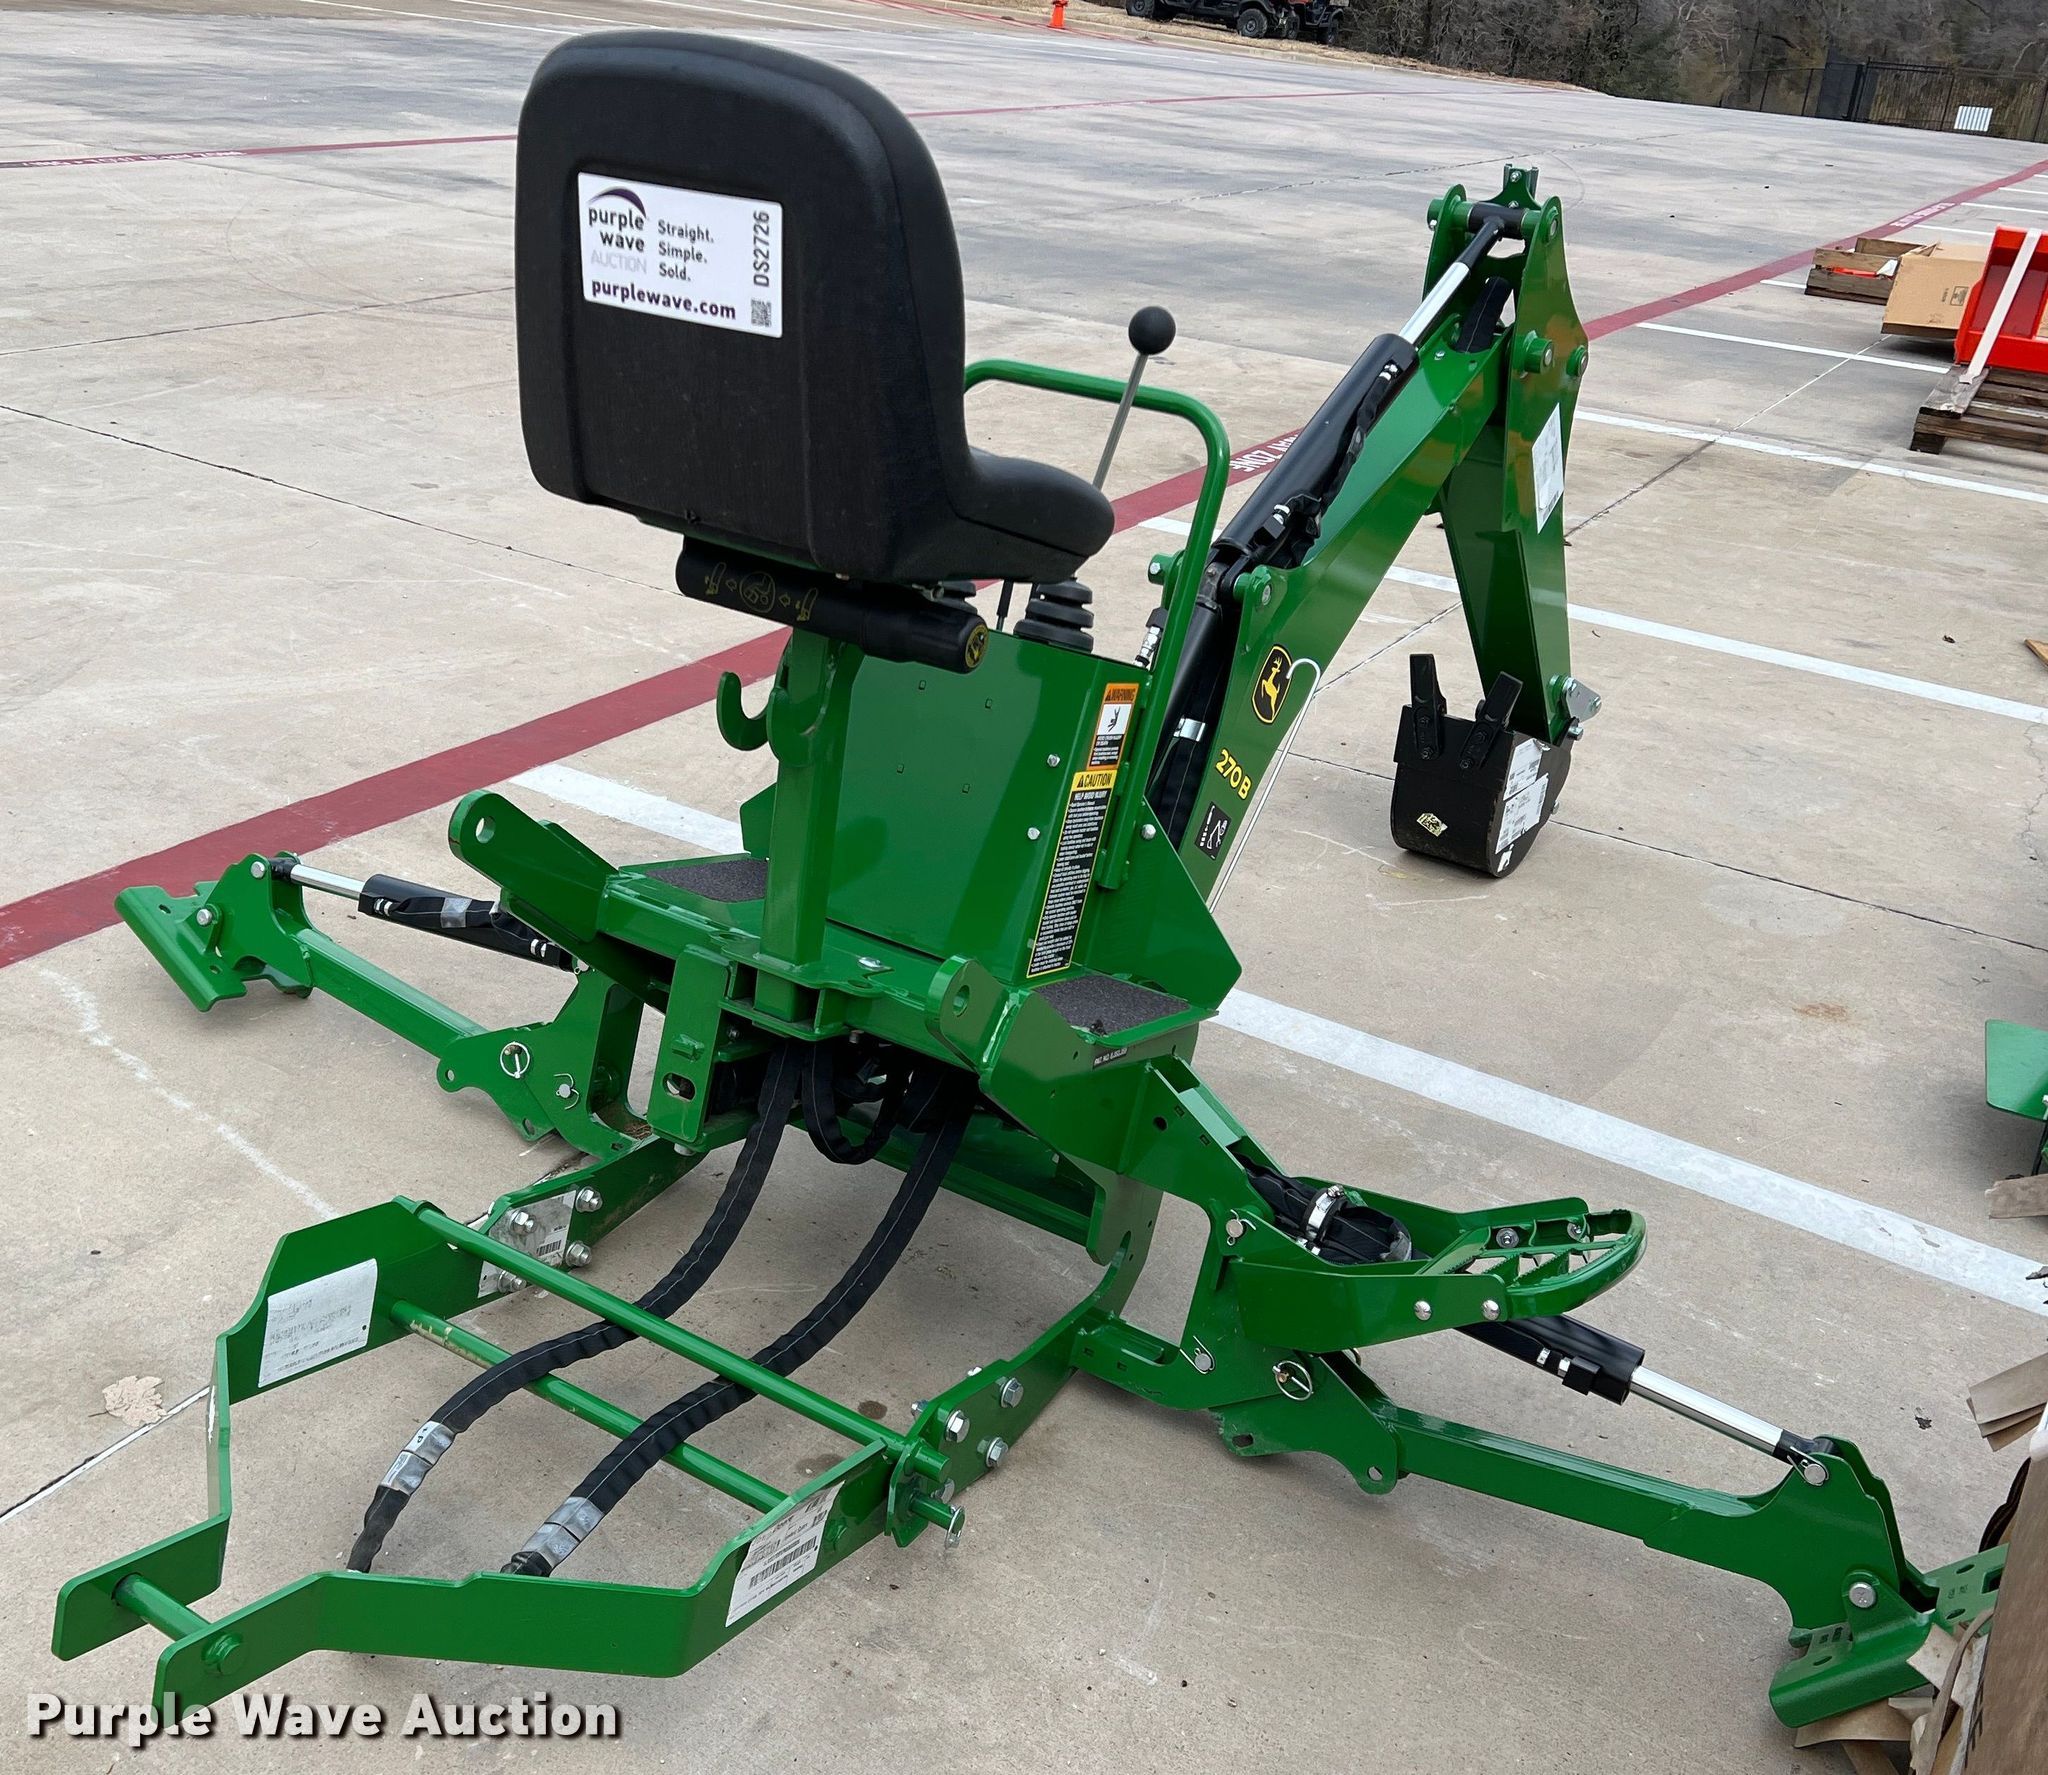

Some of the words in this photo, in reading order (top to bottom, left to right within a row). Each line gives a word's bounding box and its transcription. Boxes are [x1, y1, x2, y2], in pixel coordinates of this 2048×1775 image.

[588, 208, 645, 231] purple
[658, 219, 714, 243] Straight.
[600, 231, 645, 252] wave
[658, 242, 708, 264] Simple.
[753, 210, 770, 287] DS2726
[591, 250, 647, 274] AUCTION
[659, 263, 691, 281] Sold.
[592, 280, 736, 319] purplewave.com
[1084, 773, 1113, 787] CAUTION
[1215, 748, 1252, 800] 270B
